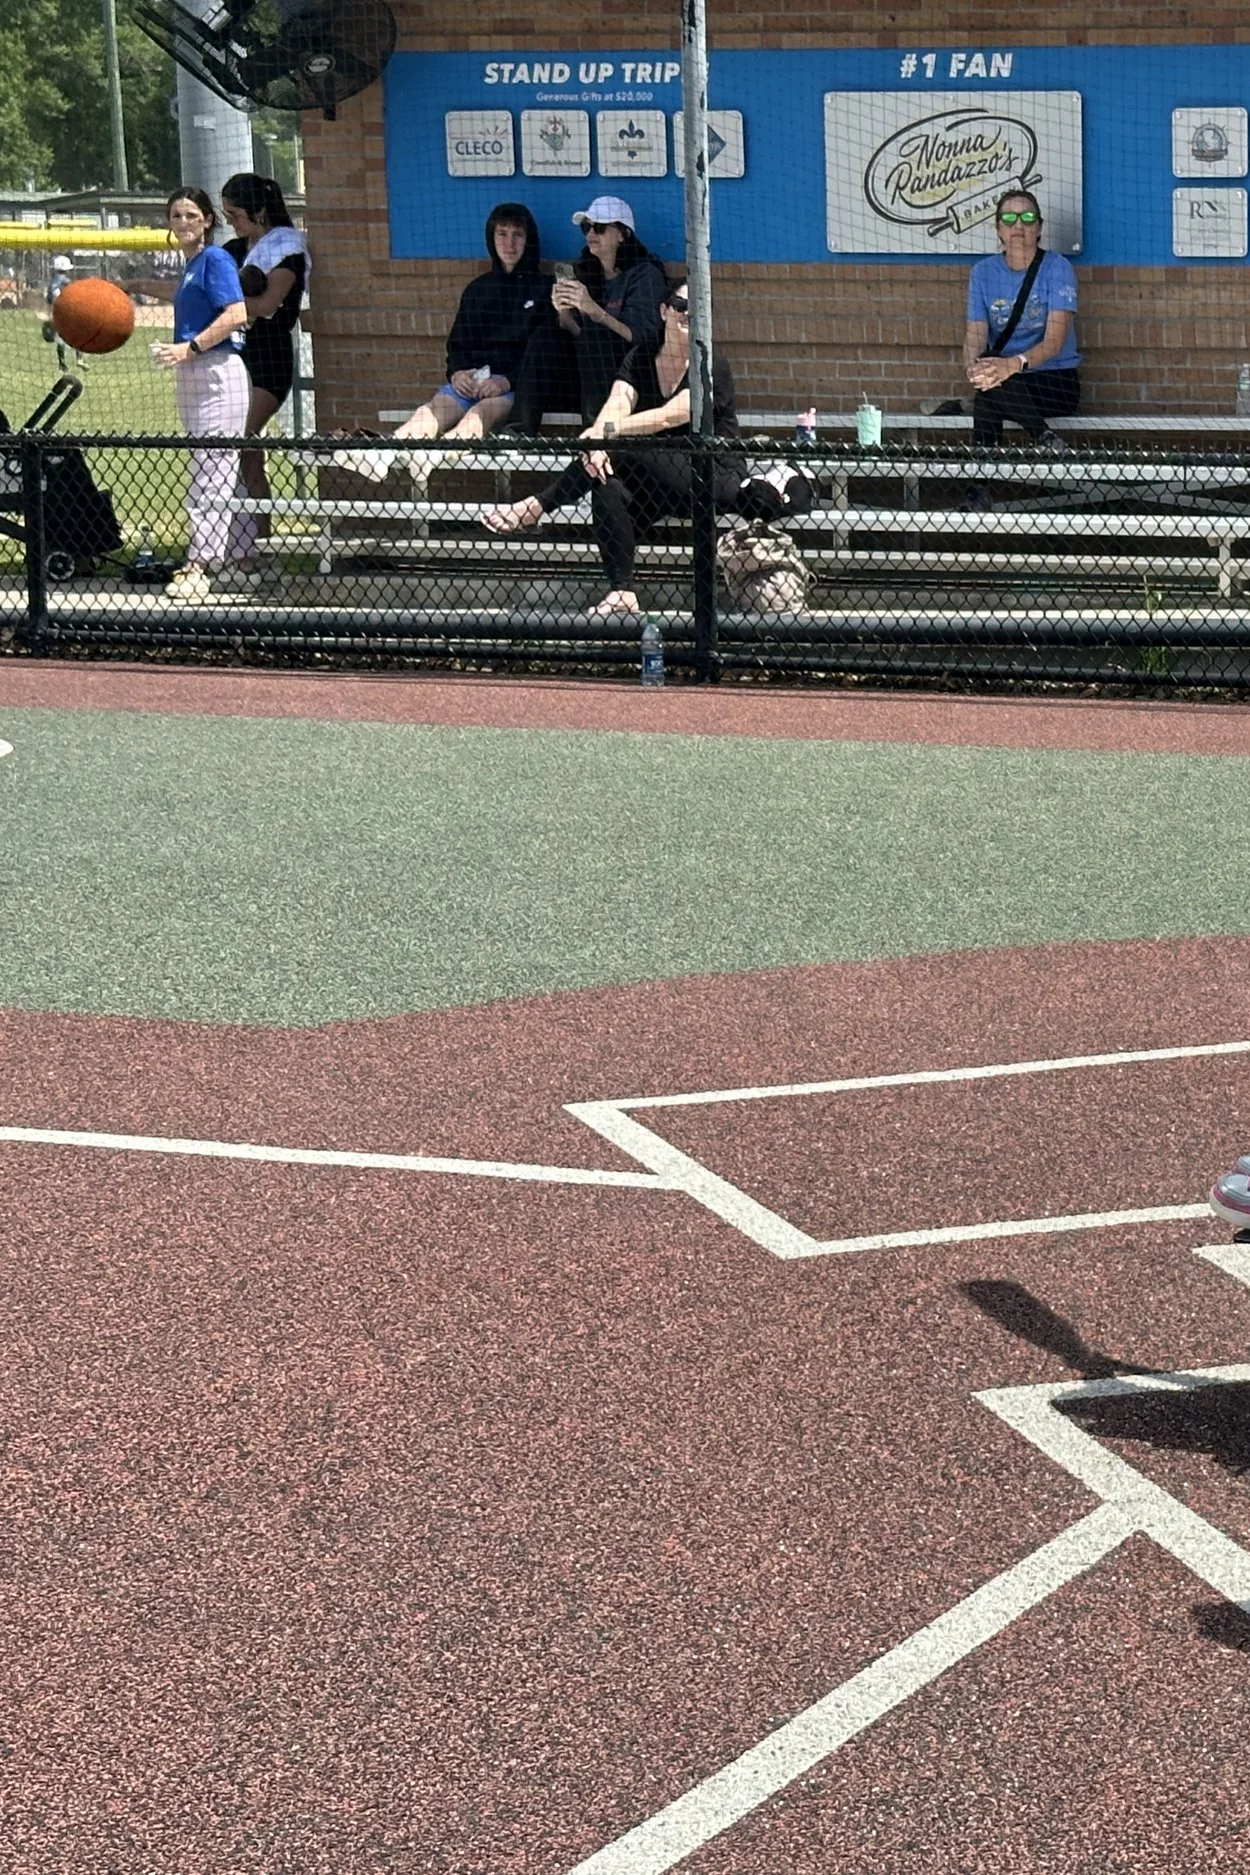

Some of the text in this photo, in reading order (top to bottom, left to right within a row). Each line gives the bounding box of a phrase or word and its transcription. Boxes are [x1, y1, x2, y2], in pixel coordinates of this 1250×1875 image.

[484, 62, 709, 84] STAND UP TRIP
[899, 53, 1013, 78] #1 FAN
[536, 91, 579, 102] Generous
[581, 90, 602, 102] Gifts
[603, 92, 613, 102] at
[455, 140, 504, 156] CLECO
[900, 125, 1001, 171] Nonna
[885, 142, 1019, 208] Randazzo's
[964, 186, 1017, 220] BAKE
